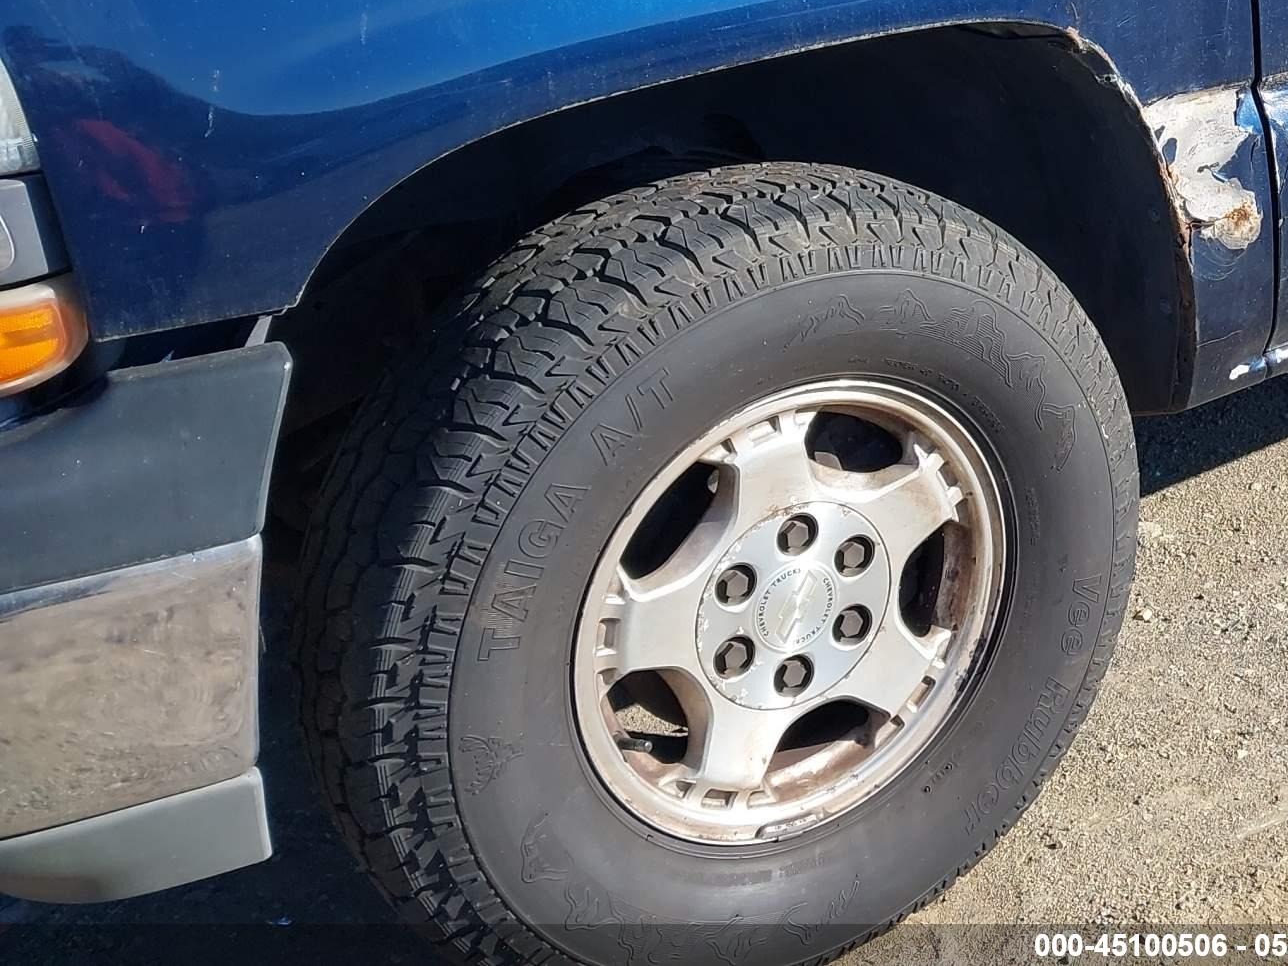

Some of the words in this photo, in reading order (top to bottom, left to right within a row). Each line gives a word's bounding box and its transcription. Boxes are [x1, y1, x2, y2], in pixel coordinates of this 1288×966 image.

[476, 482, 592, 662] TAIGA
[589, 367, 676, 466] A/T
[758, 589, 771, 637] CHEVROLET
[821, 577, 834, 625] CHEVROLET
[1060, 574, 1103, 656] Vee
[962, 674, 1071, 835] Rubber
